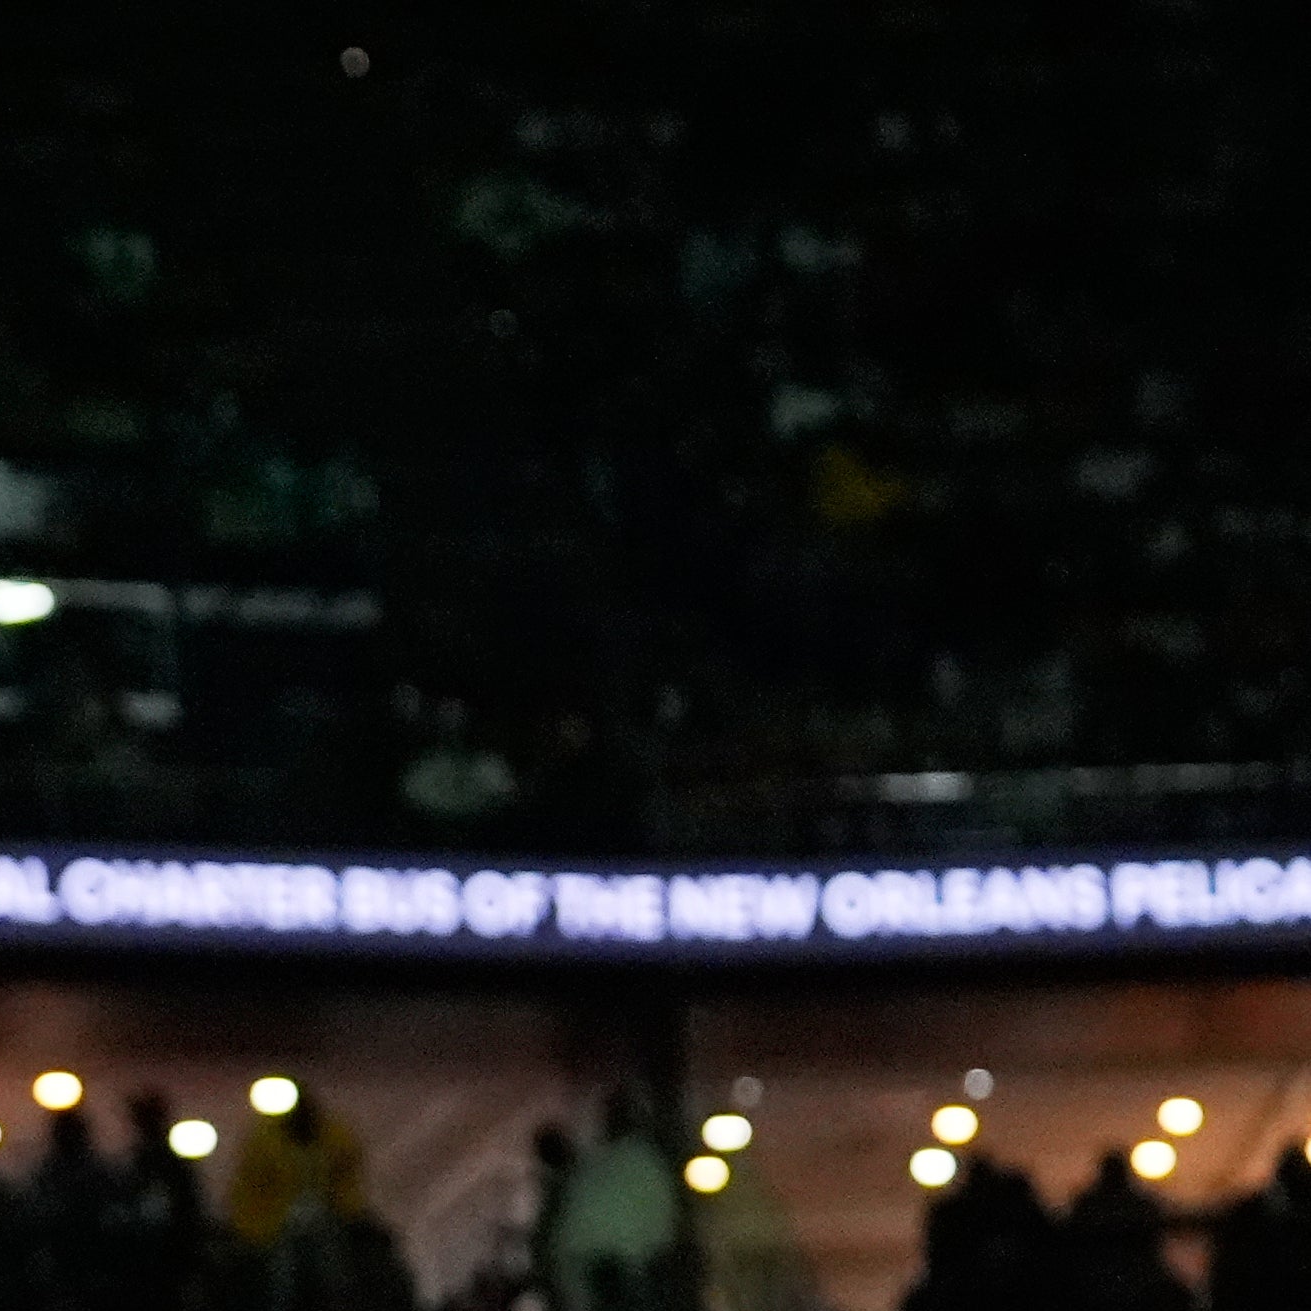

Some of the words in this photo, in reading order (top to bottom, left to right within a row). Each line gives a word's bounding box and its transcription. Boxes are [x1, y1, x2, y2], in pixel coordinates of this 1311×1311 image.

[58, 859, 338, 930] CHARTER
[340, 867, 460, 935] BUS
[463, 871, 550, 936] OF
[555, 874, 662, 941] THE
[667, 875, 818, 940] NEW
[822, 866, 1108, 937] ORLEANS
